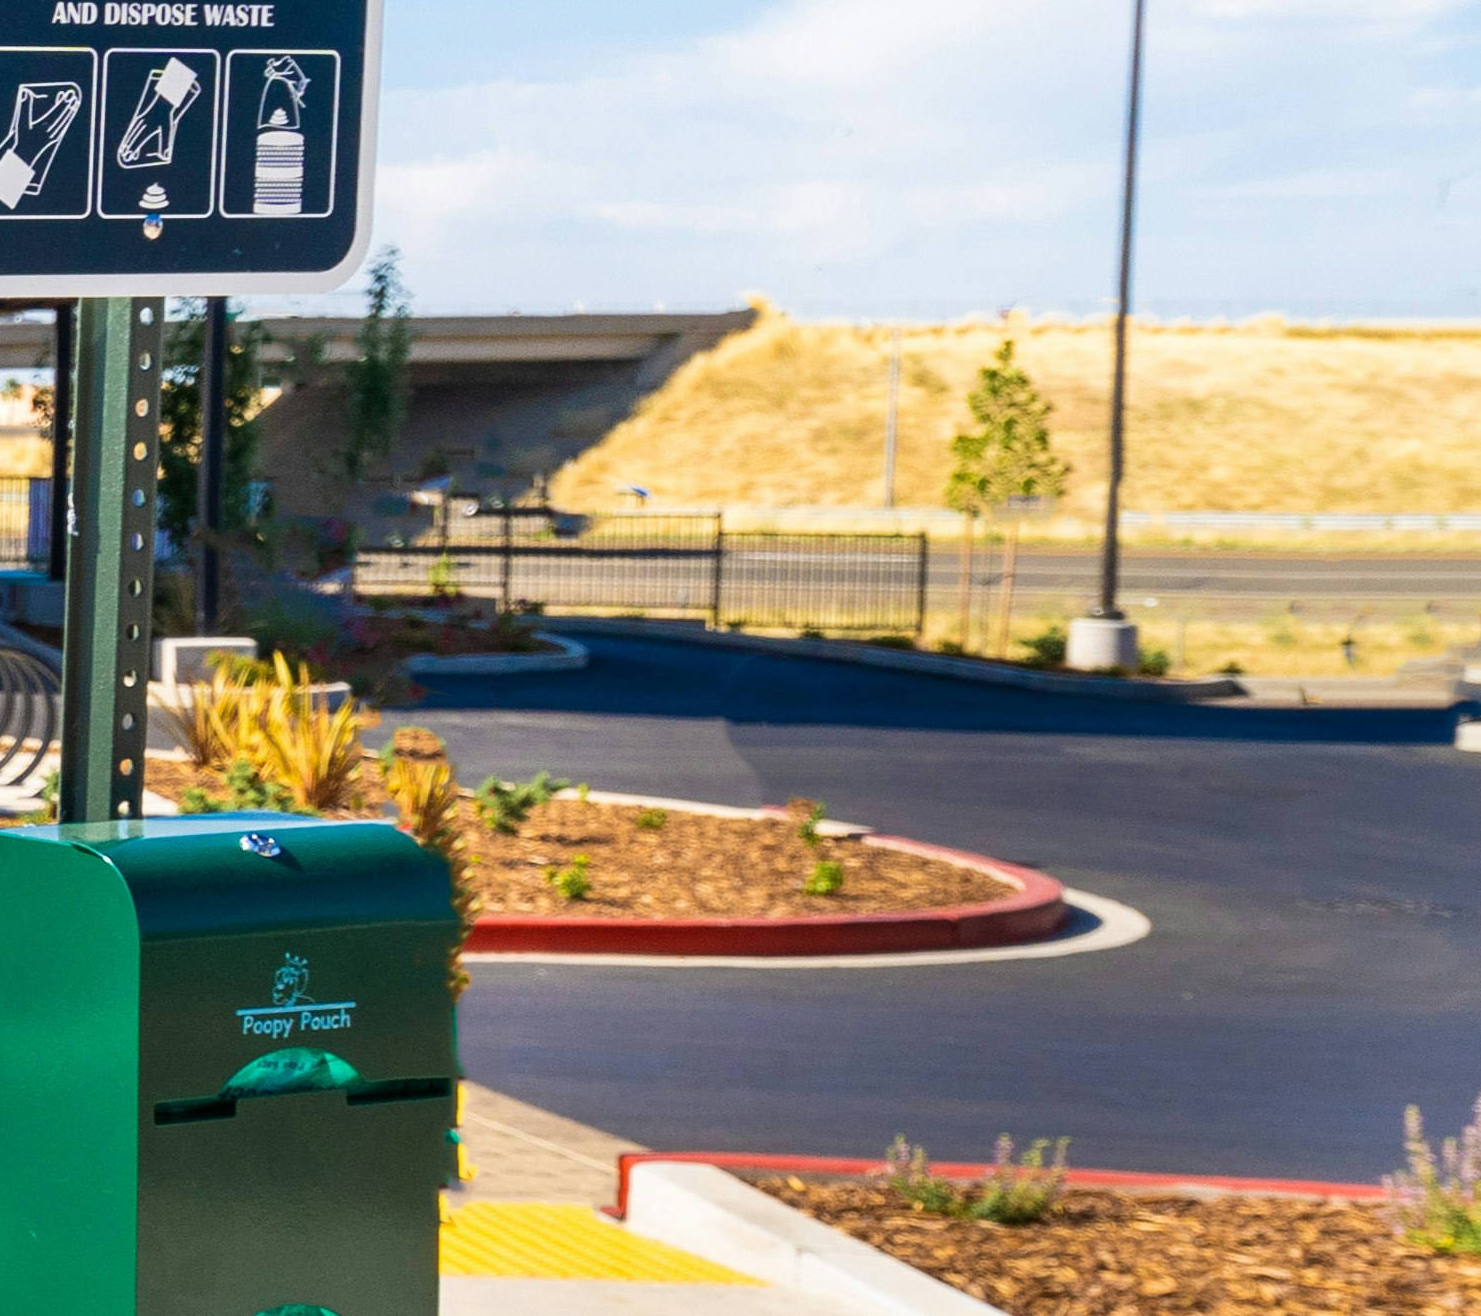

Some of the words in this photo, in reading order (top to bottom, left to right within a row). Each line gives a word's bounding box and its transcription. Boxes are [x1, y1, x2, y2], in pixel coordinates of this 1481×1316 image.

[51, 1, 98, 25] AND
[103, 2, 199, 26] DISPOSE
[204, 4, 275, 27] WASTE
[242, 1015, 295, 1039] Poopy
[299, 1008, 352, 1031] Pouch
